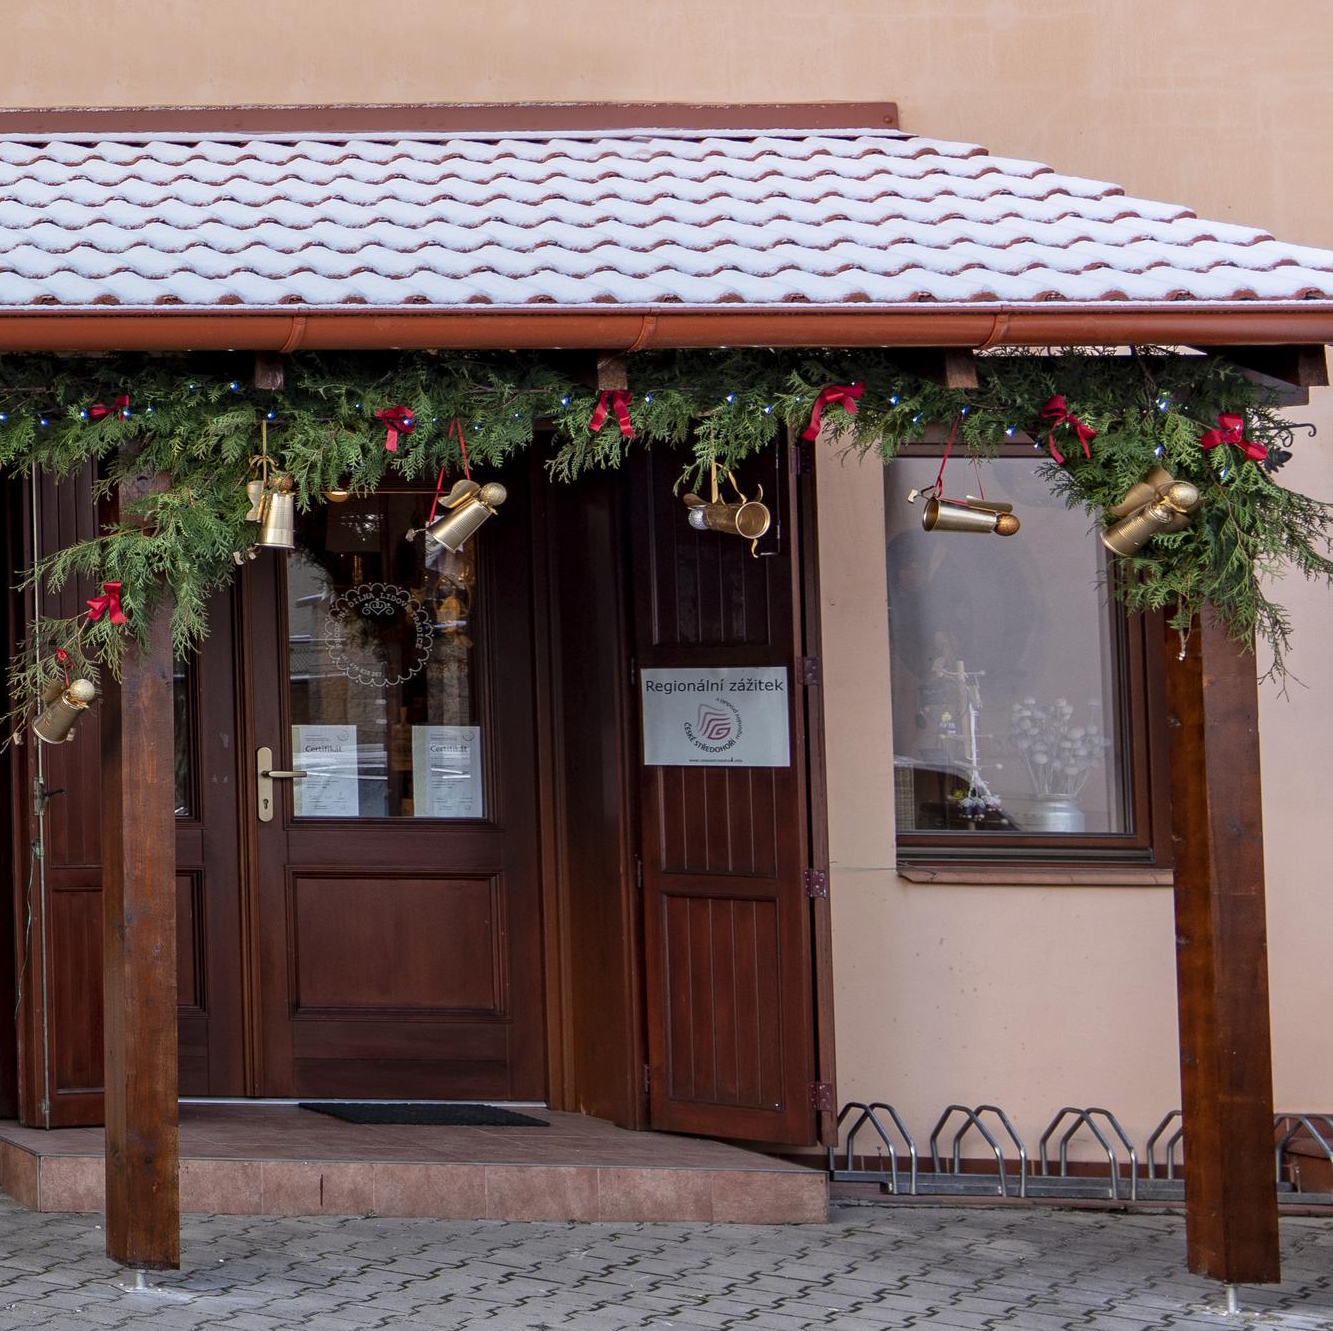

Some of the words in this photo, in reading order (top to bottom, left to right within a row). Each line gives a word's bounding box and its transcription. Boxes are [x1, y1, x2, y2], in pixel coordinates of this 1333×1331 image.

[645, 679, 724, 694] Regionální
[730, 678, 783, 692] zážitek
[684, 722, 697, 742] ČESKÉ
